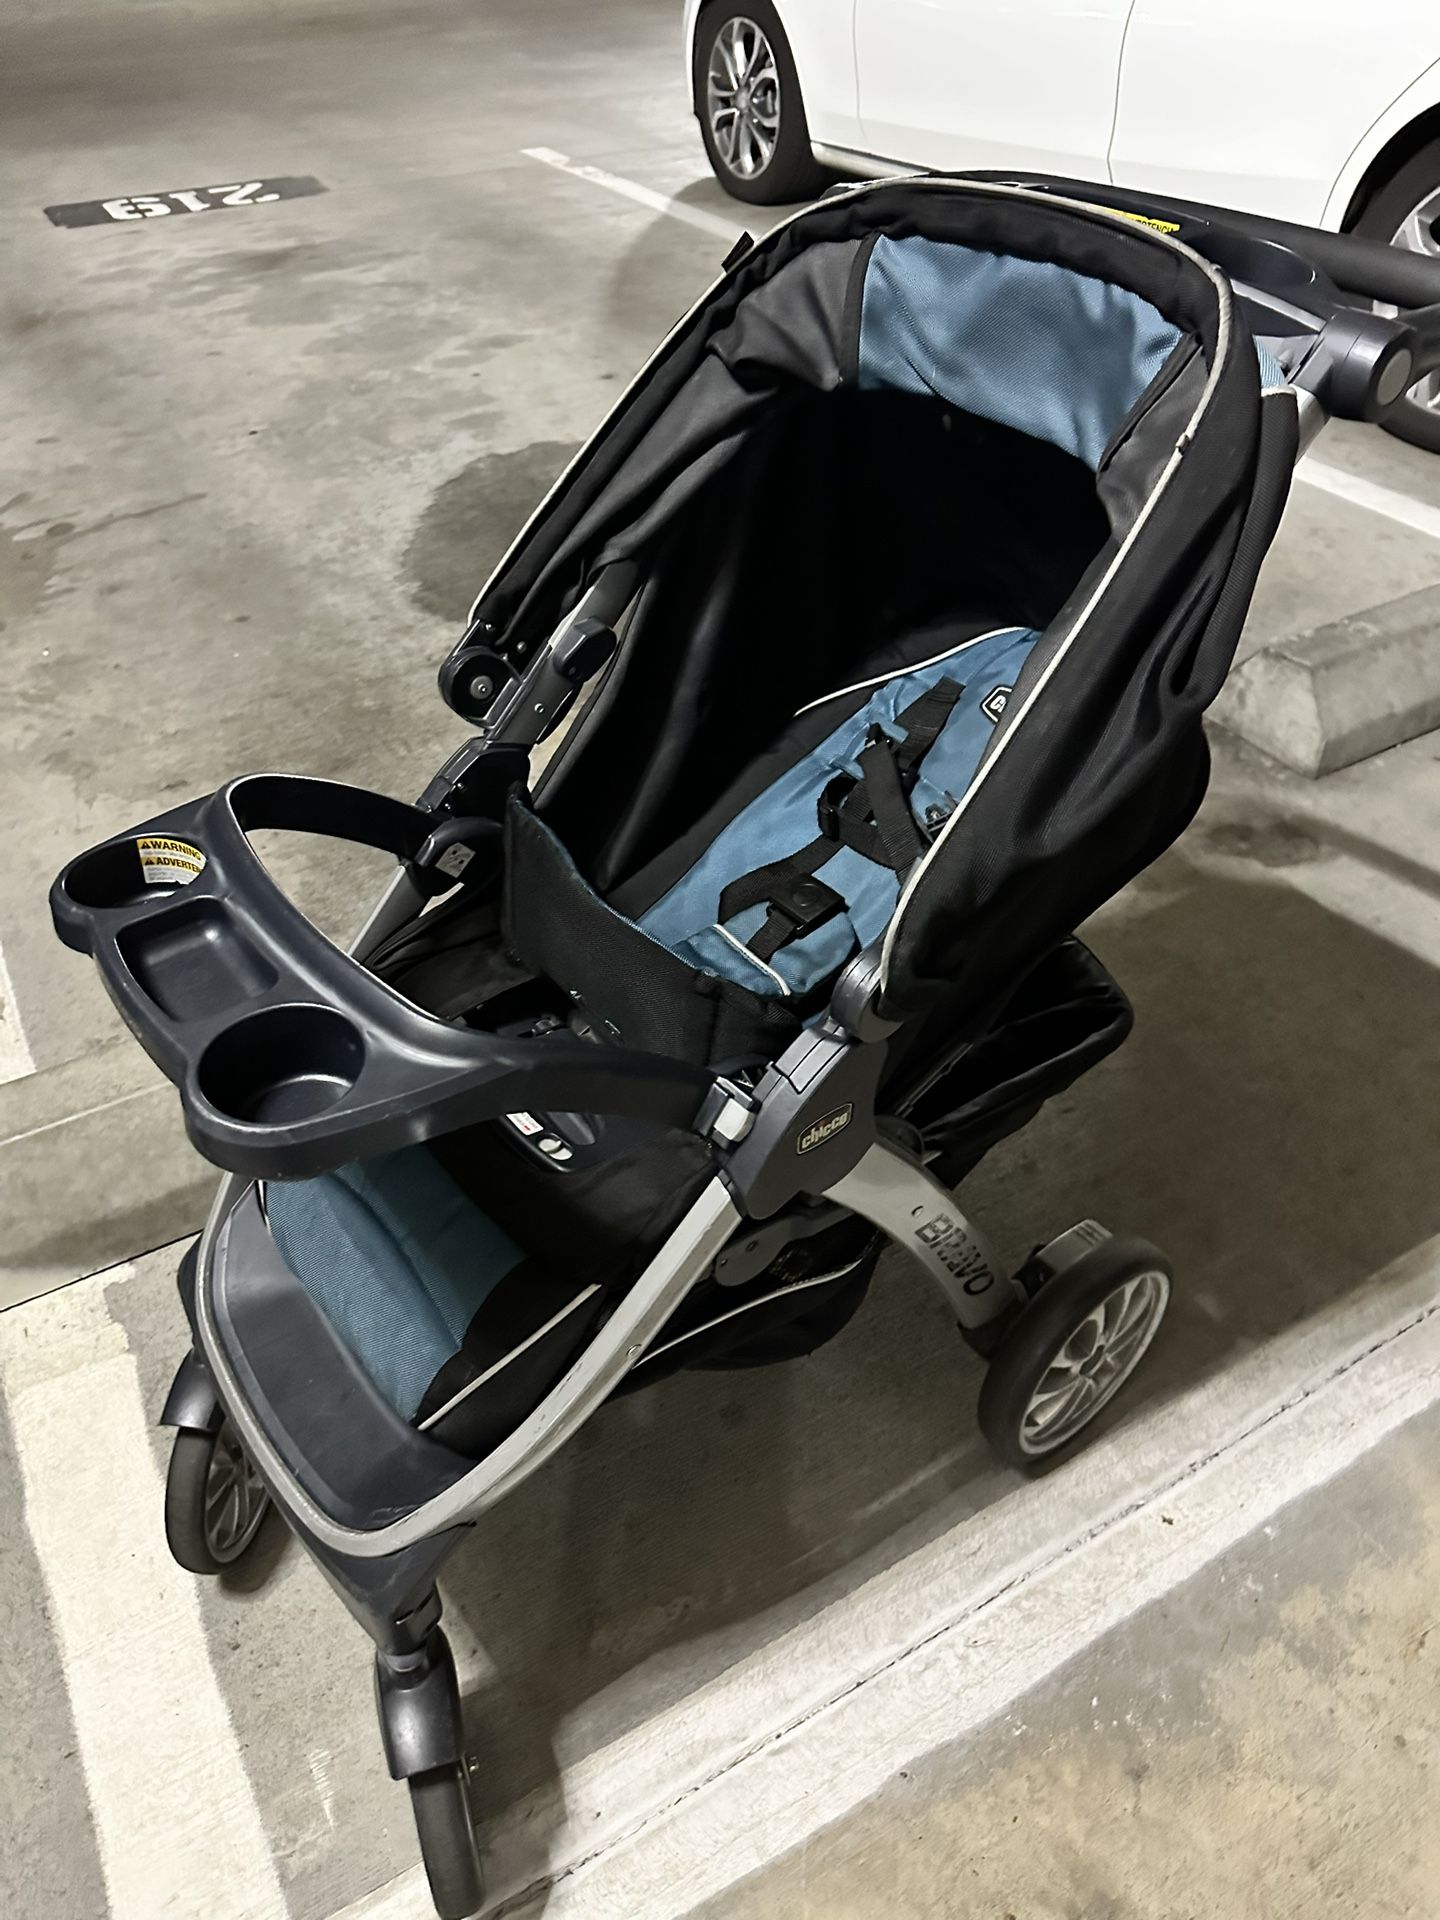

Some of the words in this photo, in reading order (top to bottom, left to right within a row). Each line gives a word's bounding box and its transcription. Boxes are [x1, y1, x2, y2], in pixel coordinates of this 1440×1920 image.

[150, 841, 201, 860] WARNING
[801, 1112, 848, 1149] chicco
[914, 1213, 995, 1295] BRAVO
